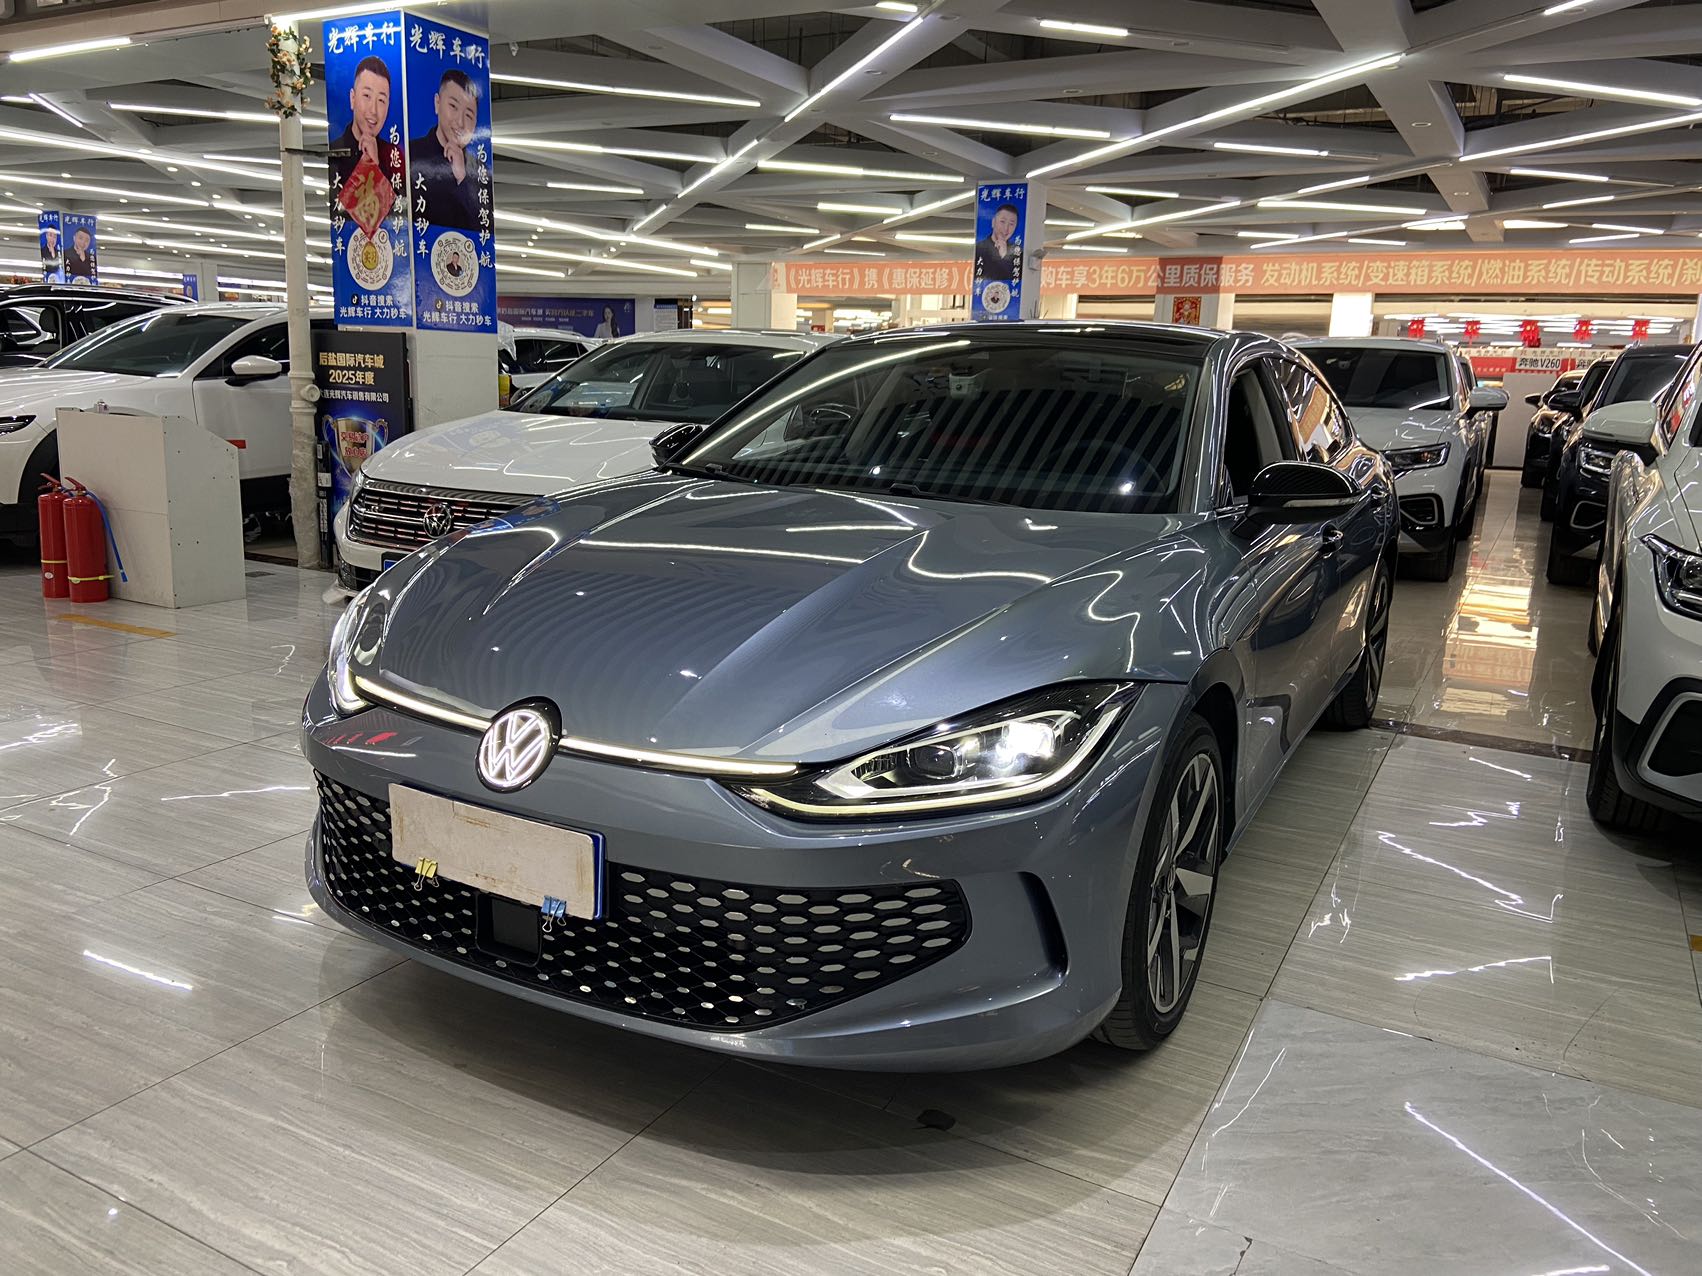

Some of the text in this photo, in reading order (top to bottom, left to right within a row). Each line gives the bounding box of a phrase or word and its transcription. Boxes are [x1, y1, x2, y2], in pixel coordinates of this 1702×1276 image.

[327, 22, 395, 54] 光辉车行
[409, 24, 485, 69] 光辉车行
[980, 187, 1025, 202] 光辉车行
[476, 143, 493, 268] 为您保驾护航
[413, 173, 430, 259] 大力秒车
[787, 265, 972, 290] 《光辉车行》携《惠保延修》(
[1040, 262, 1255, 288] 购车享3年6万公里质保服务
[361, 294, 394, 306] 抖音搜索
[445, 300, 479, 313] 抖音搜索
[340, 306, 407, 319] 光辉车行 大力秒车
[423, 310, 492, 326] 光辉车行 大力秒车
[319, 352, 385, 369] 后盐国际汽车城
[329, 369, 375, 386] 2025年度
